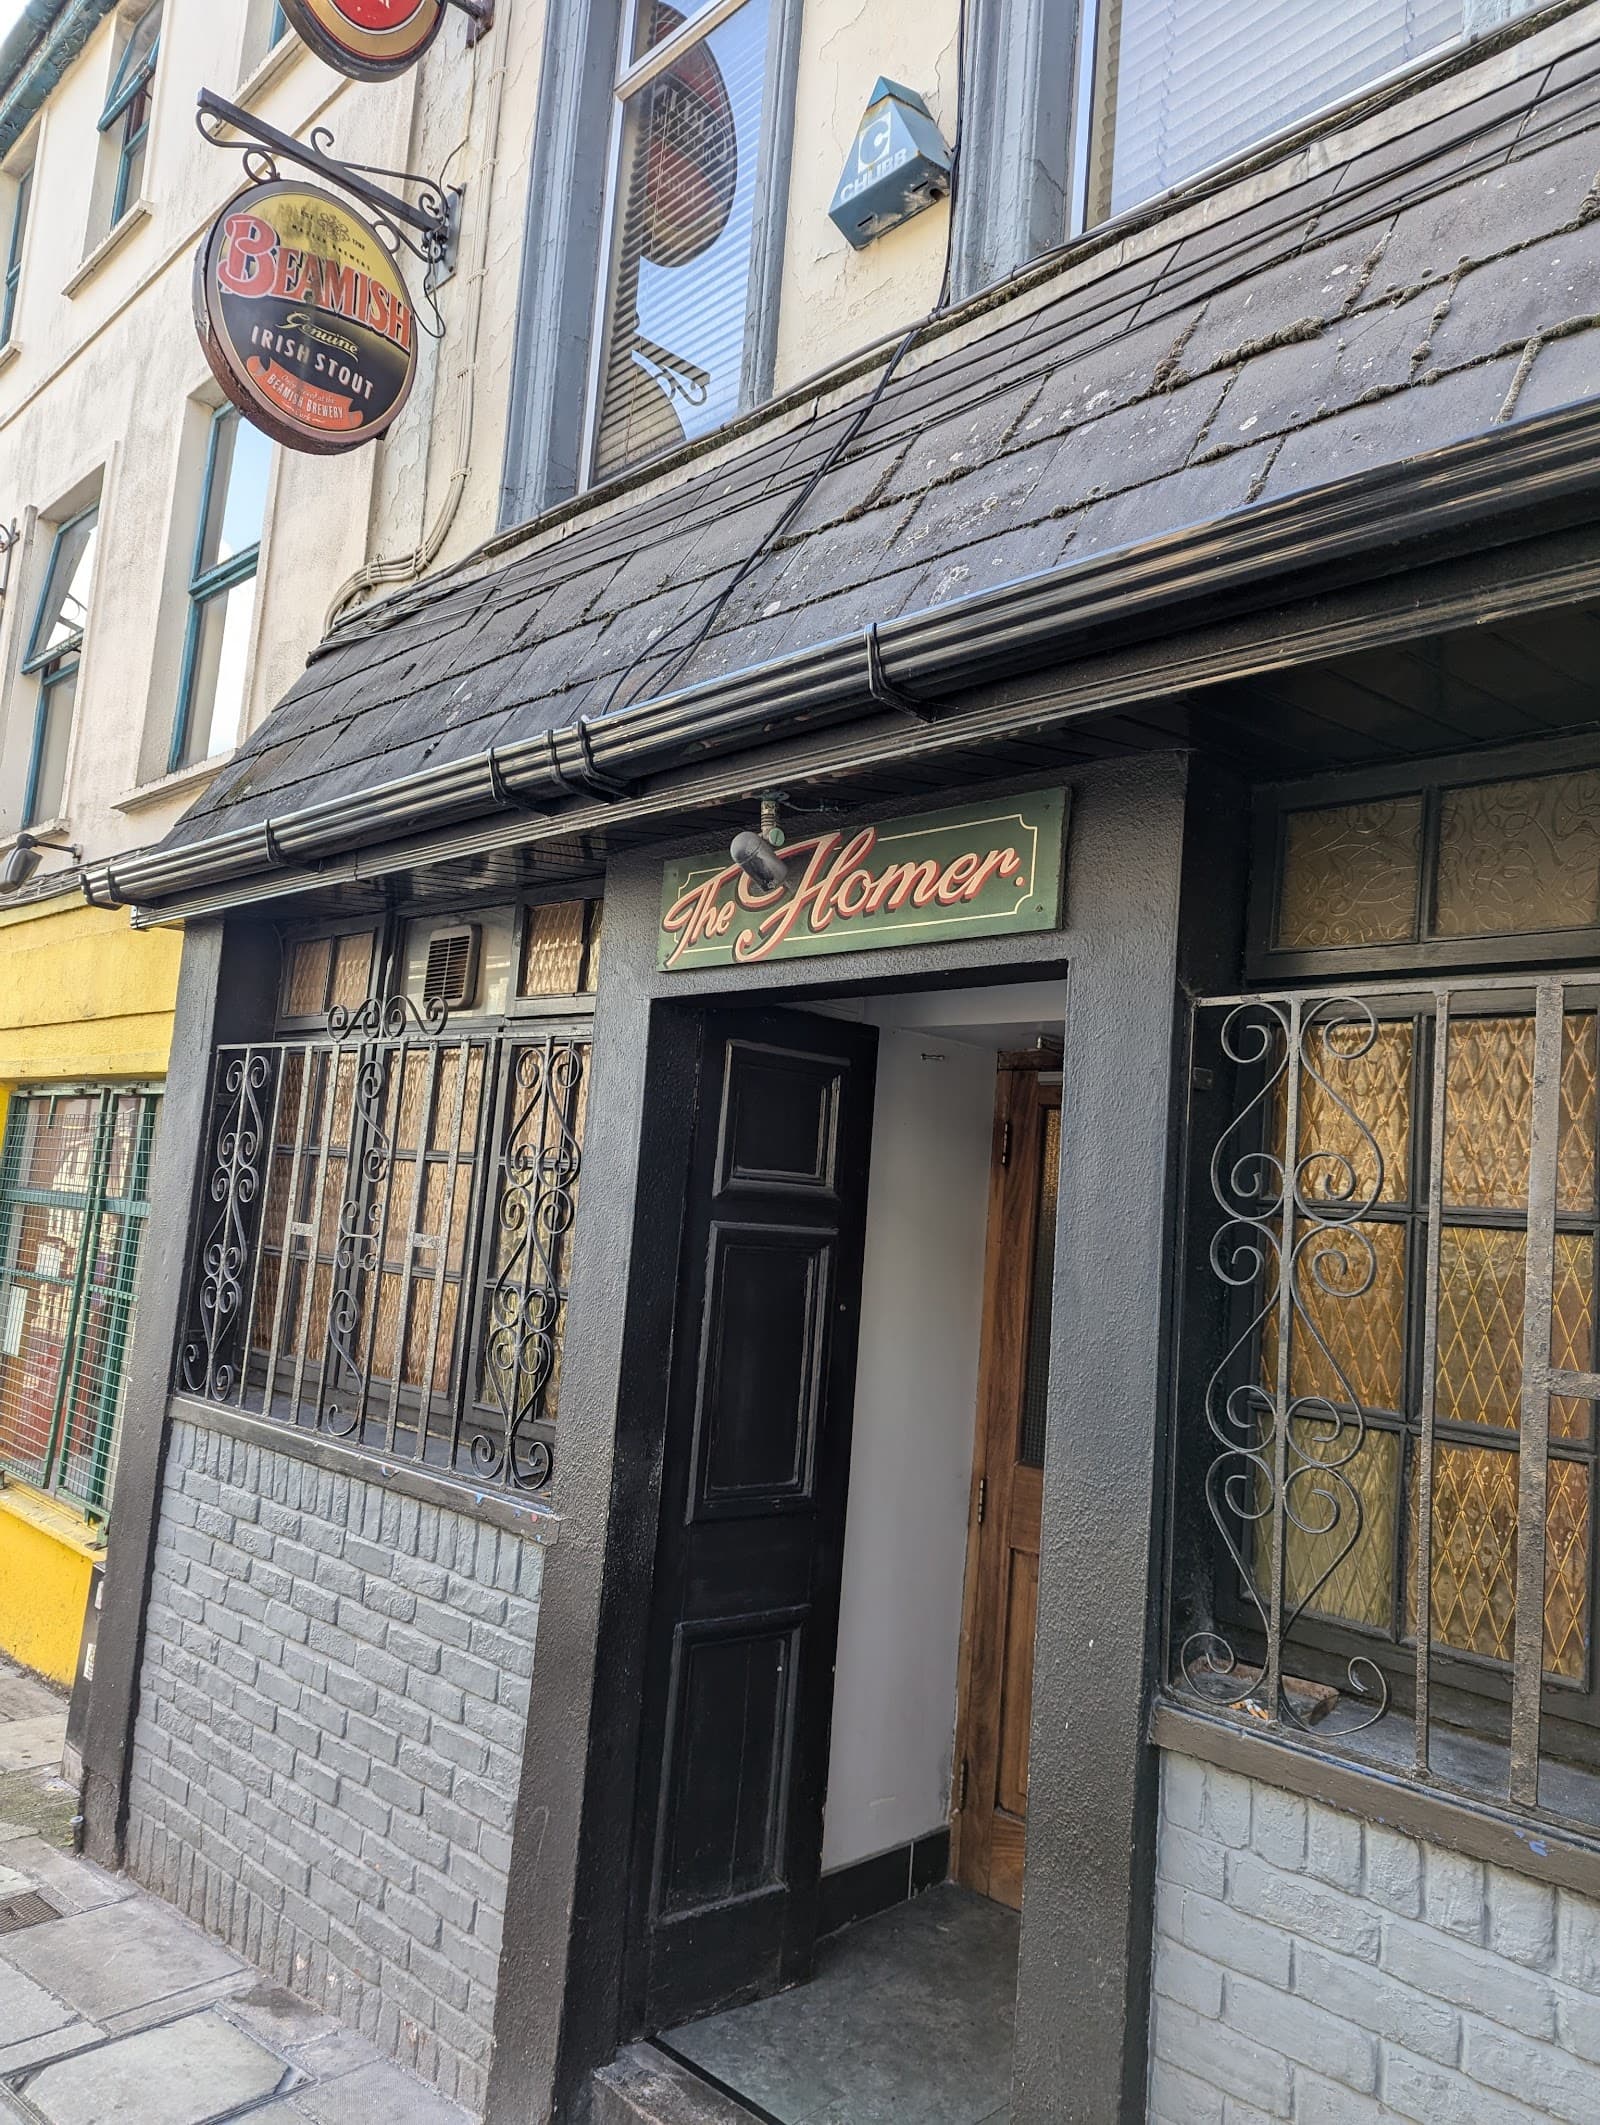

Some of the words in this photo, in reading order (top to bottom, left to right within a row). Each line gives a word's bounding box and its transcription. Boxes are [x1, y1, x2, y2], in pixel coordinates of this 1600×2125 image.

[840, 149, 907, 200] CHUBB
[216, 213, 411, 350] BEAMISH
[251, 325, 310, 364] IRISH
[314, 353, 374, 400] STOUT
[275, 311, 358, 355] Genuine
[267, 373, 304, 408] BEAMISH
[306, 399, 343, 419] BREWERY
[662, 864, 743, 967] The
[732, 827, 1026, 962] Homer.
